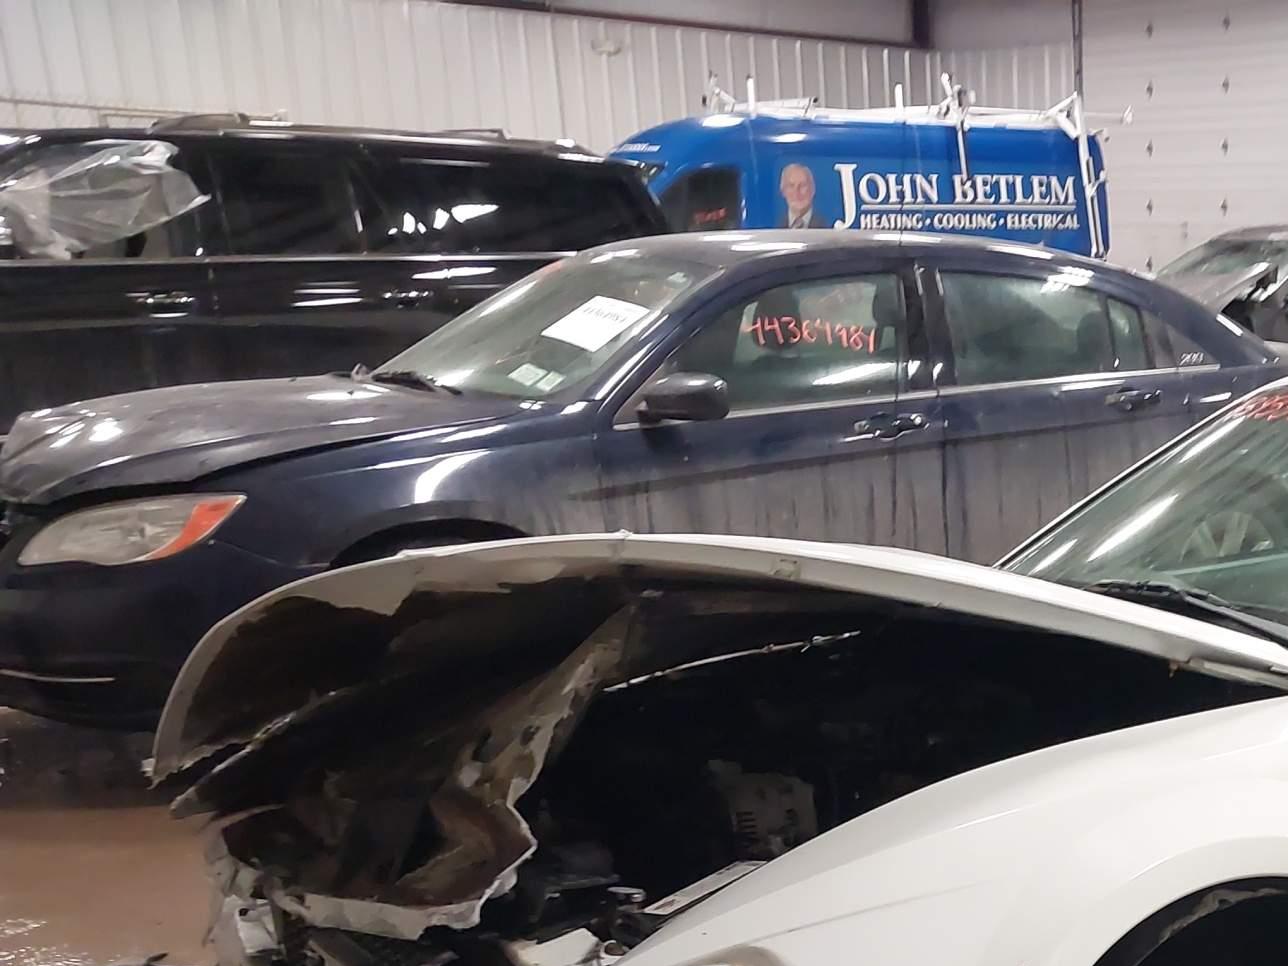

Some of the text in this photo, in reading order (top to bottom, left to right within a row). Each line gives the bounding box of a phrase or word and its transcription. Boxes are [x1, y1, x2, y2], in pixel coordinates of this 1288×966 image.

[834, 163, 1078, 231] JOHN BETLEM
[860, 212, 923, 231] HEATING
[933, 213, 998, 231] COOLING
